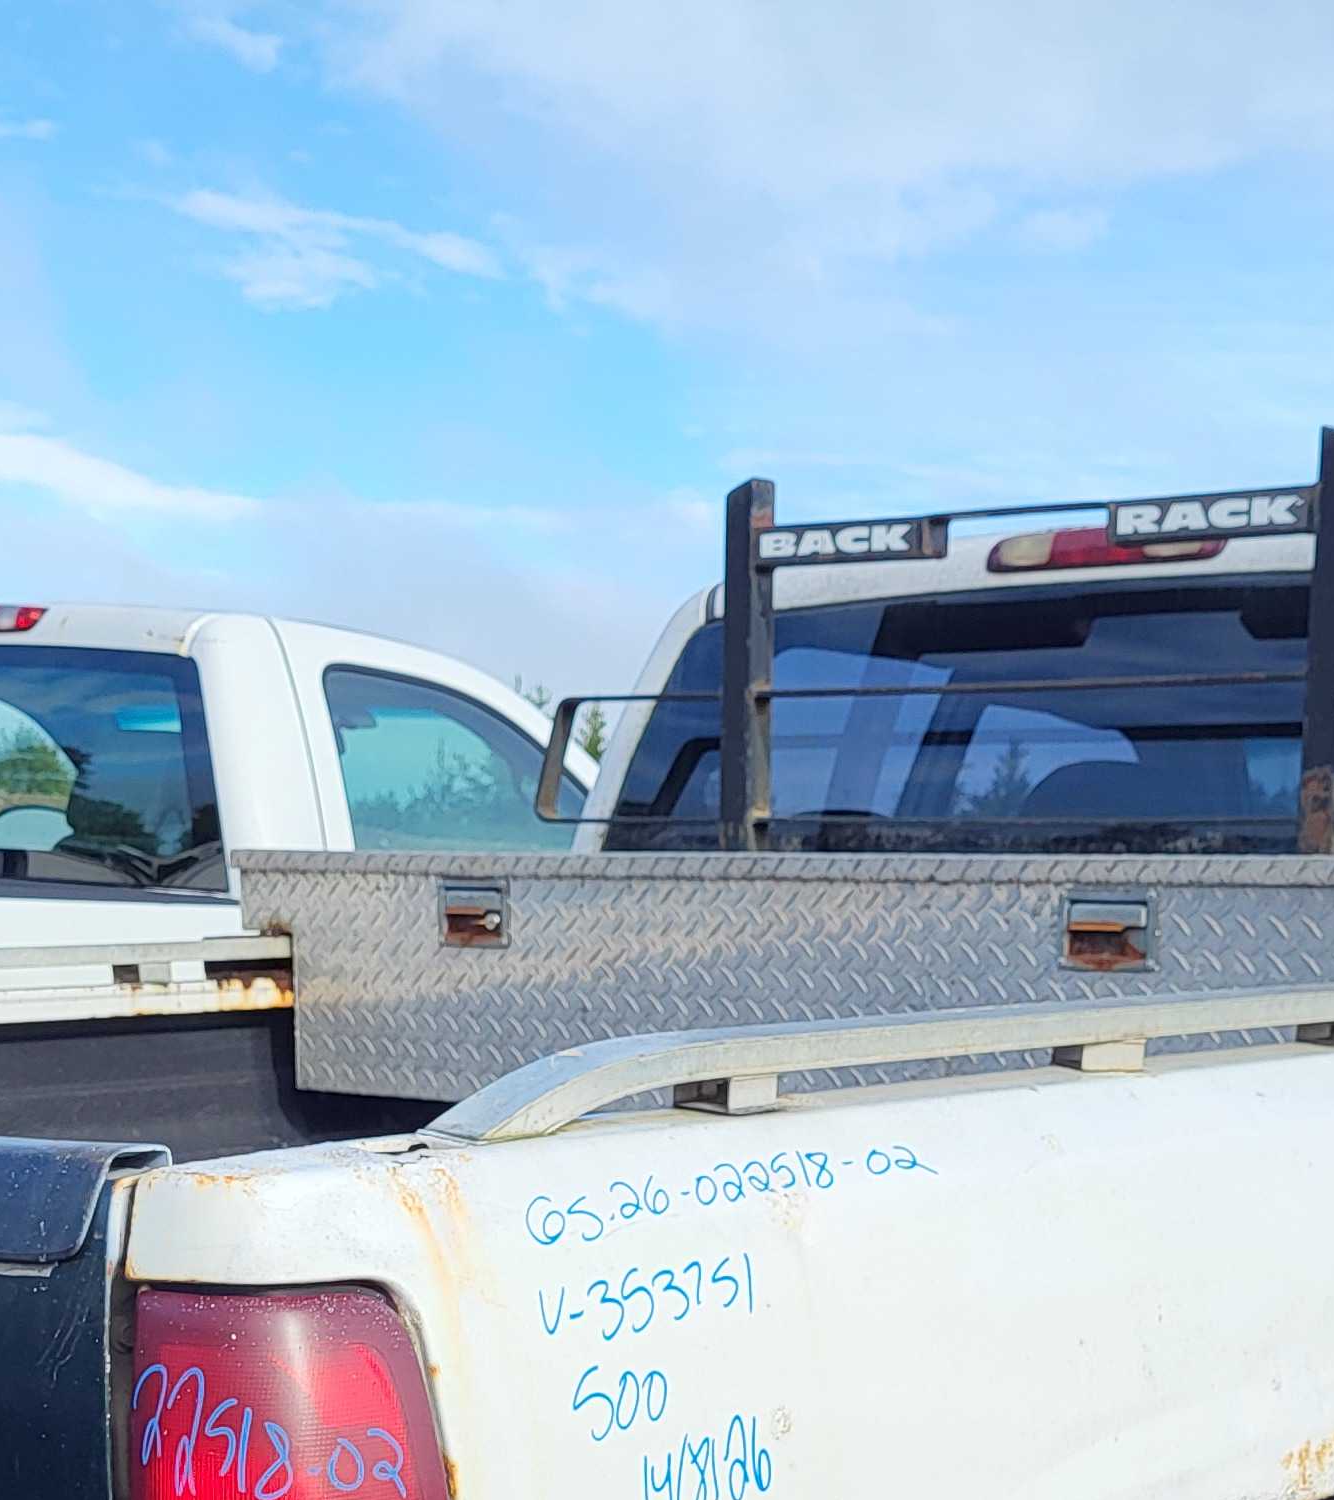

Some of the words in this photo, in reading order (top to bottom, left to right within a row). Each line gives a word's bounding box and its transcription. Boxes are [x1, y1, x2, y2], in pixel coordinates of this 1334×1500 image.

[759, 523, 912, 560] BACK
[1114, 494, 1301, 538] RACK
[572, 1365, 669, 1441] 500
